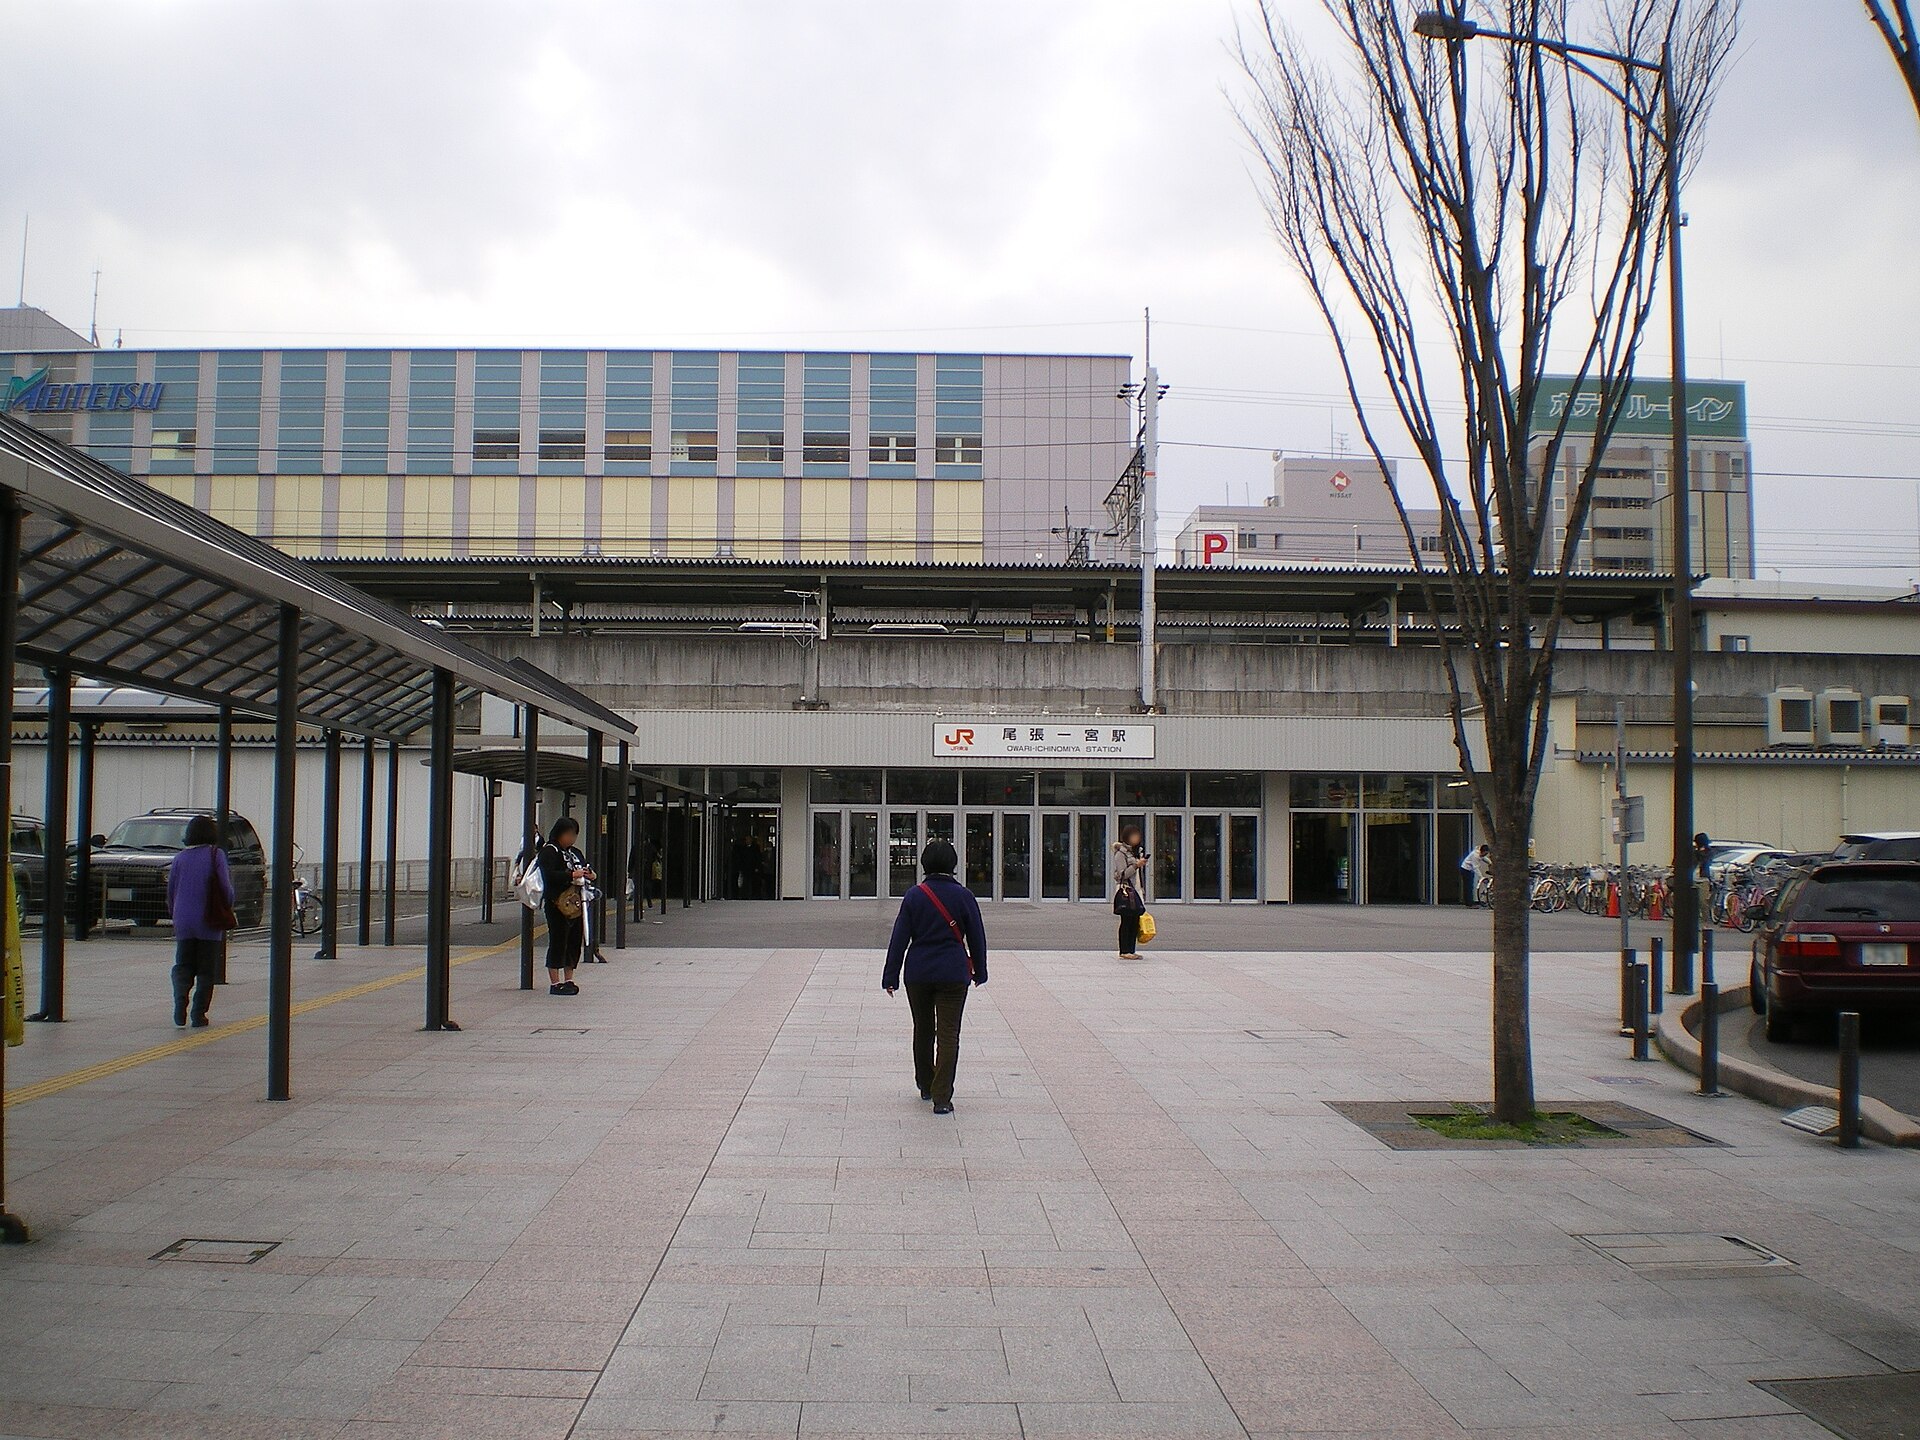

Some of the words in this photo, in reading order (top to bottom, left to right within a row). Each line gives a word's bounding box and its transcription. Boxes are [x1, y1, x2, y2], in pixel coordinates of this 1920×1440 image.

[2, 362, 164, 412] MEITETSU
[1549, 392, 1734, 422] ホテルーイン
[1204, 533, 1228, 565] P
[944, 728, 975, 746] JR
[1002, 727, 1126, 742] 尾張一宮駅
[1006, 745, 1081, 753] OWARI-ICHINOMIYA
[1085, 745, 1122, 753] STATION
